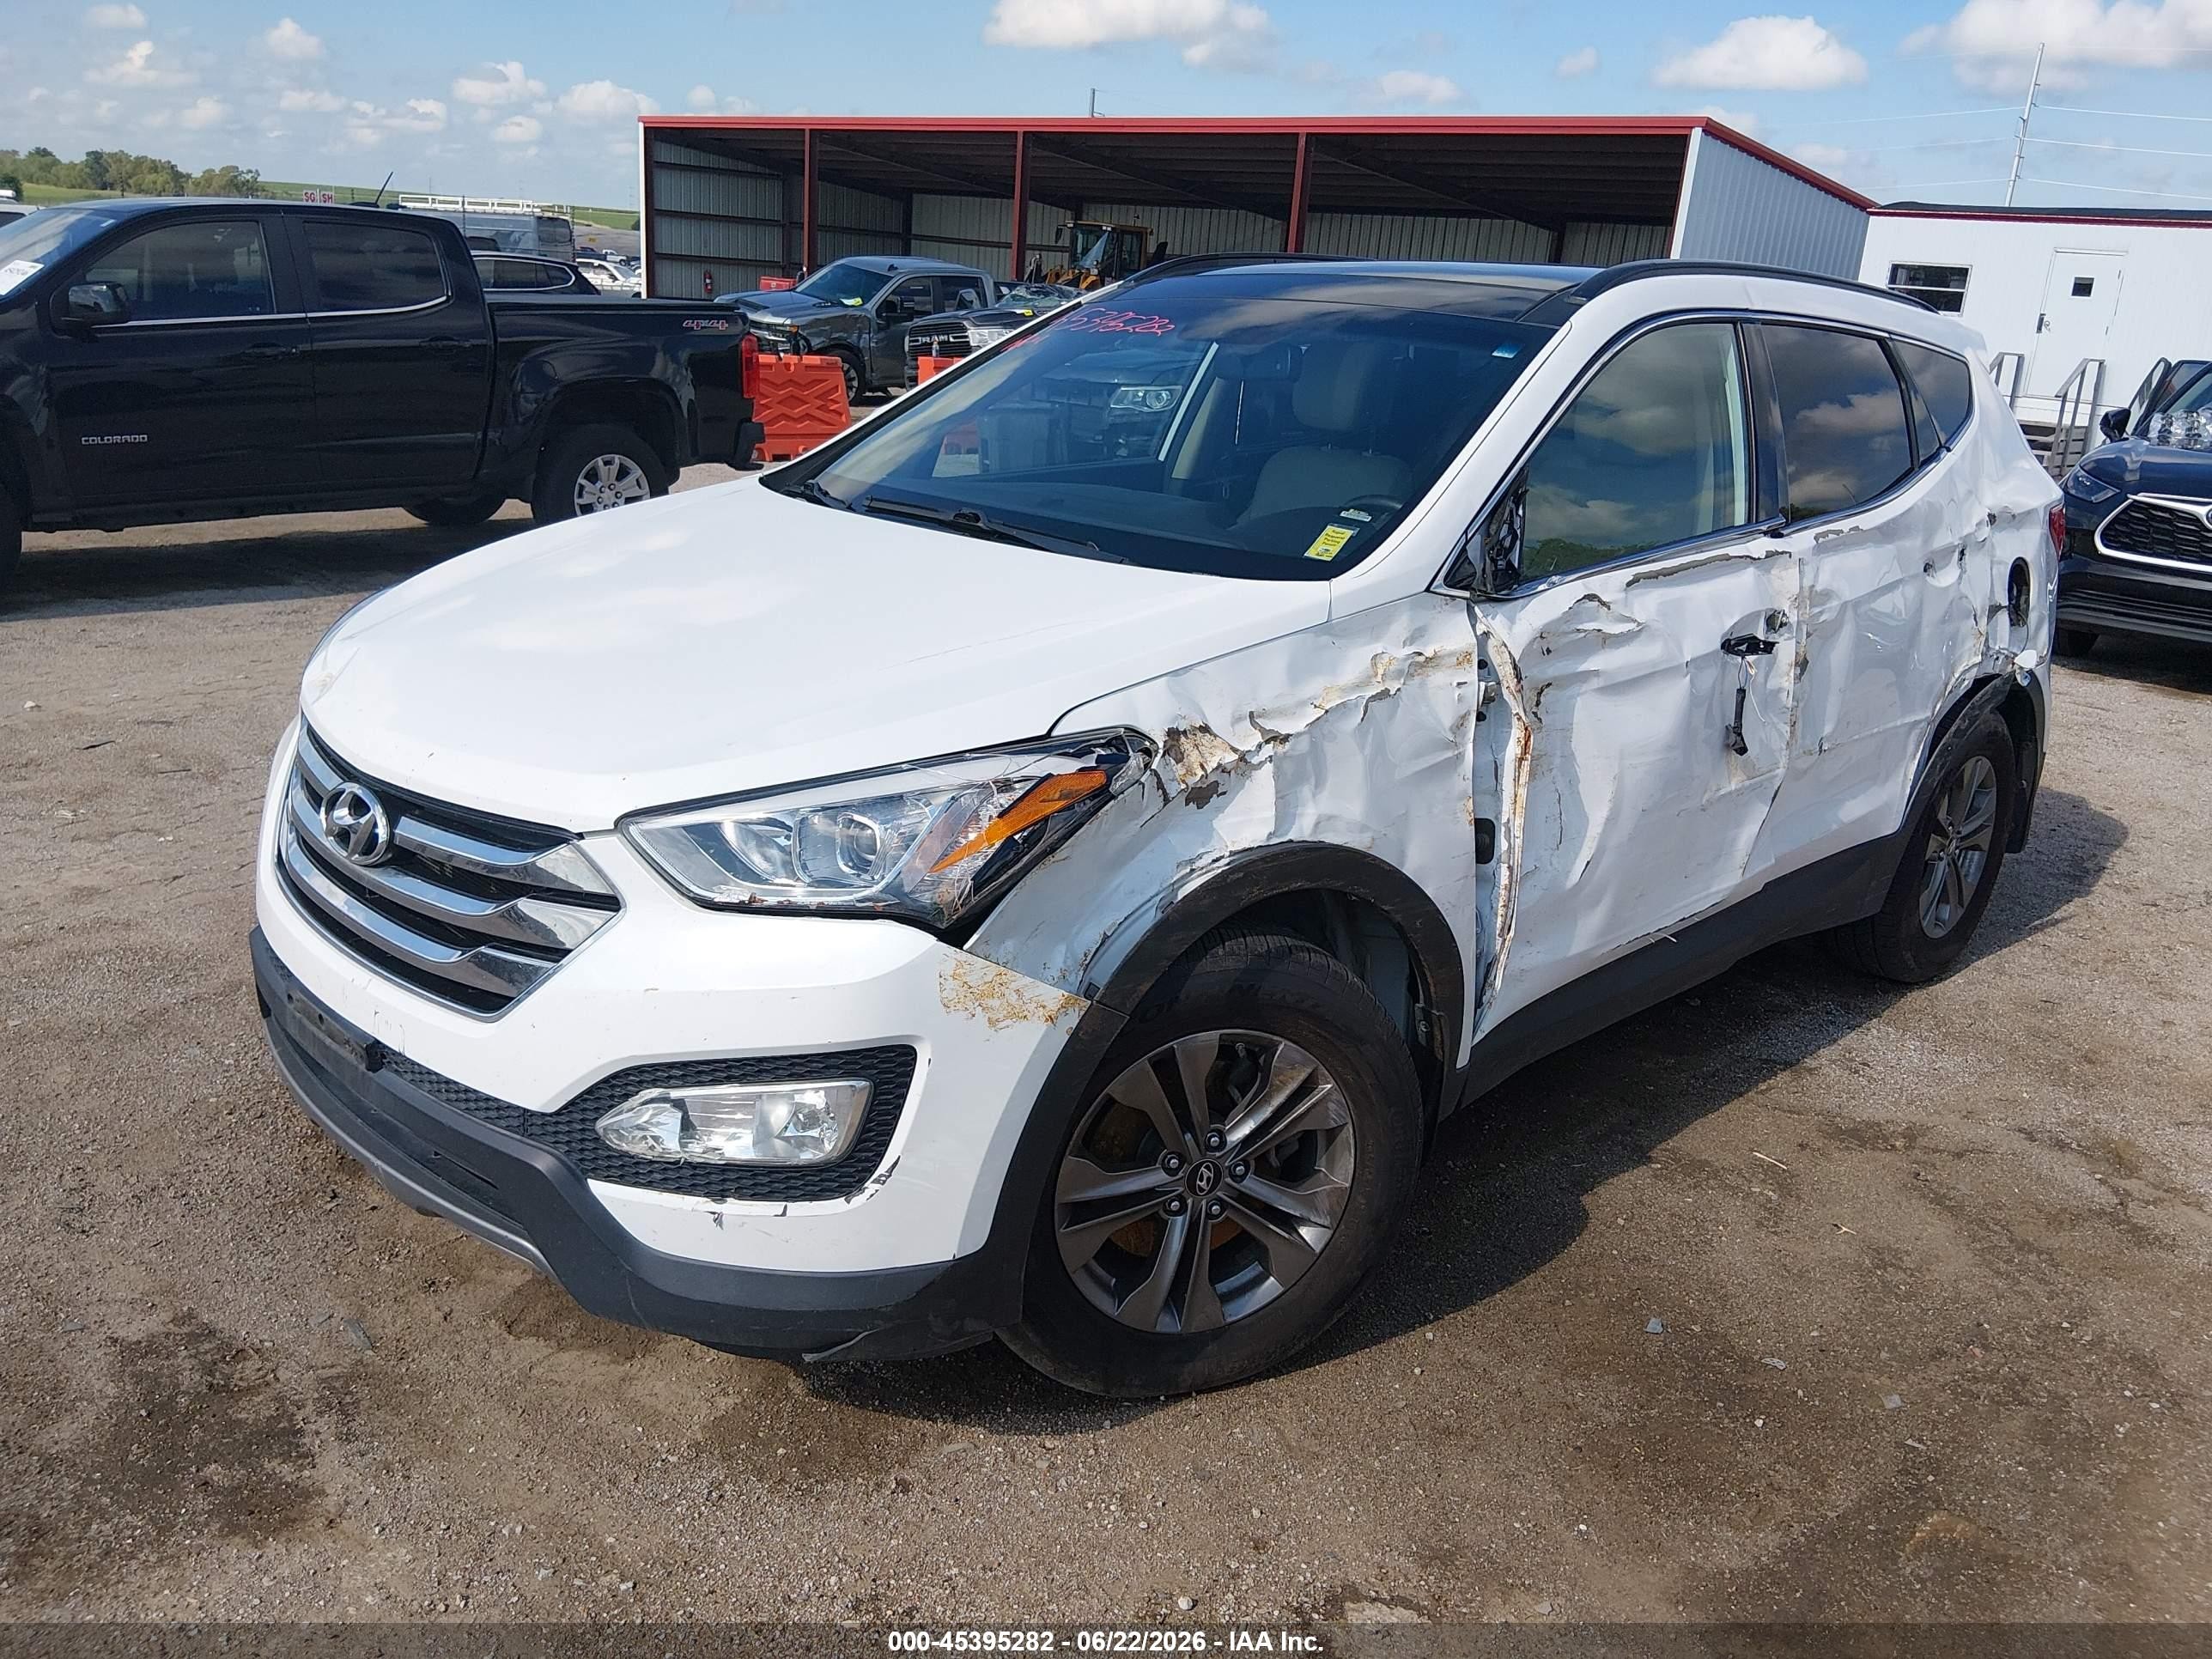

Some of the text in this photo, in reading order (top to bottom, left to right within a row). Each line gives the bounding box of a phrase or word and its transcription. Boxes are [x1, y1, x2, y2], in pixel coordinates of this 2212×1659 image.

[322, 193, 333, 204] SH
[921, 334, 949, 343] RAM
[81, 434, 148, 445] COLORADO
